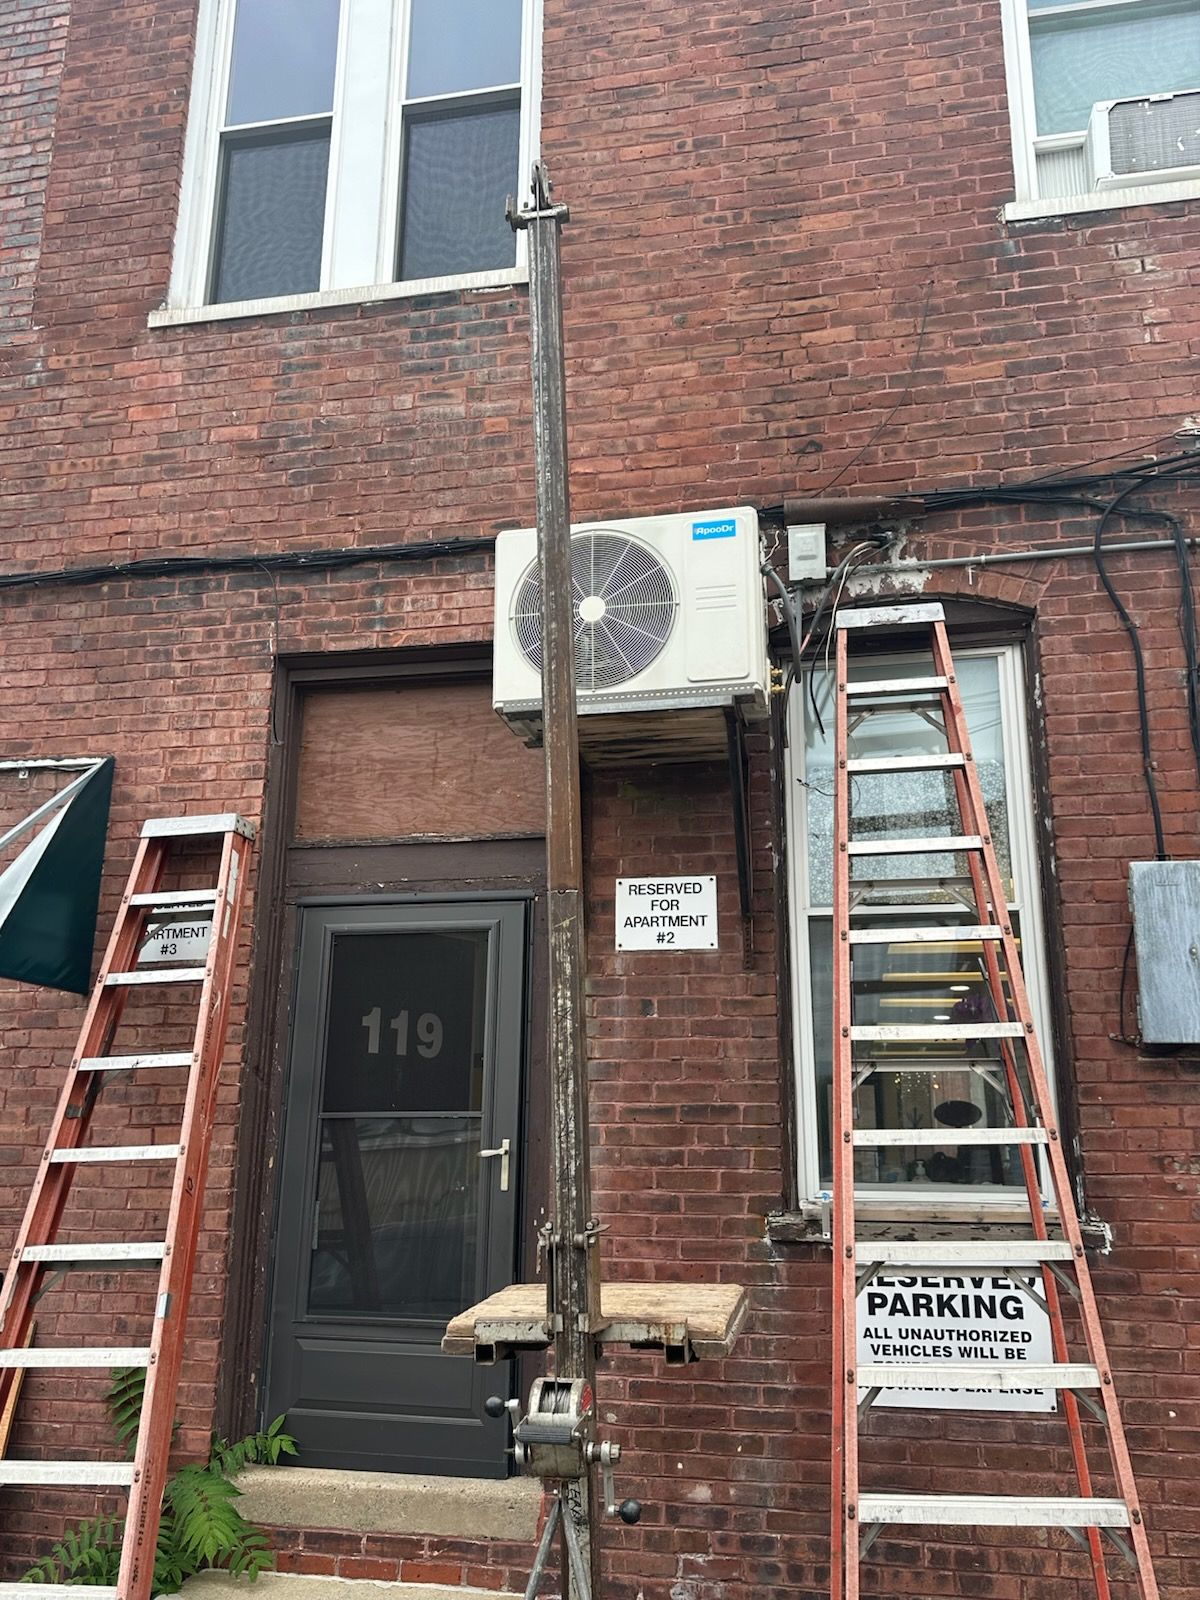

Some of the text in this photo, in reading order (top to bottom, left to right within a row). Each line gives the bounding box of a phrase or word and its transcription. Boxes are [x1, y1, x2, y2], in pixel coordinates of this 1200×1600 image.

[628, 882, 703, 895] RESERVED
[651, 899, 680, 911] FOR
[623, 915, 708, 928] APARTMENT
[656, 932, 675, 944] #2
[160, 944, 177, 955] #3
[361, 1007, 443, 1058] 119
[867, 1292, 1025, 1320] PARKING
[863, 1327, 1032, 1343] ALL UNAUTHORIZED
[870, 1344, 1027, 1360] VEHICLES WILL BE
